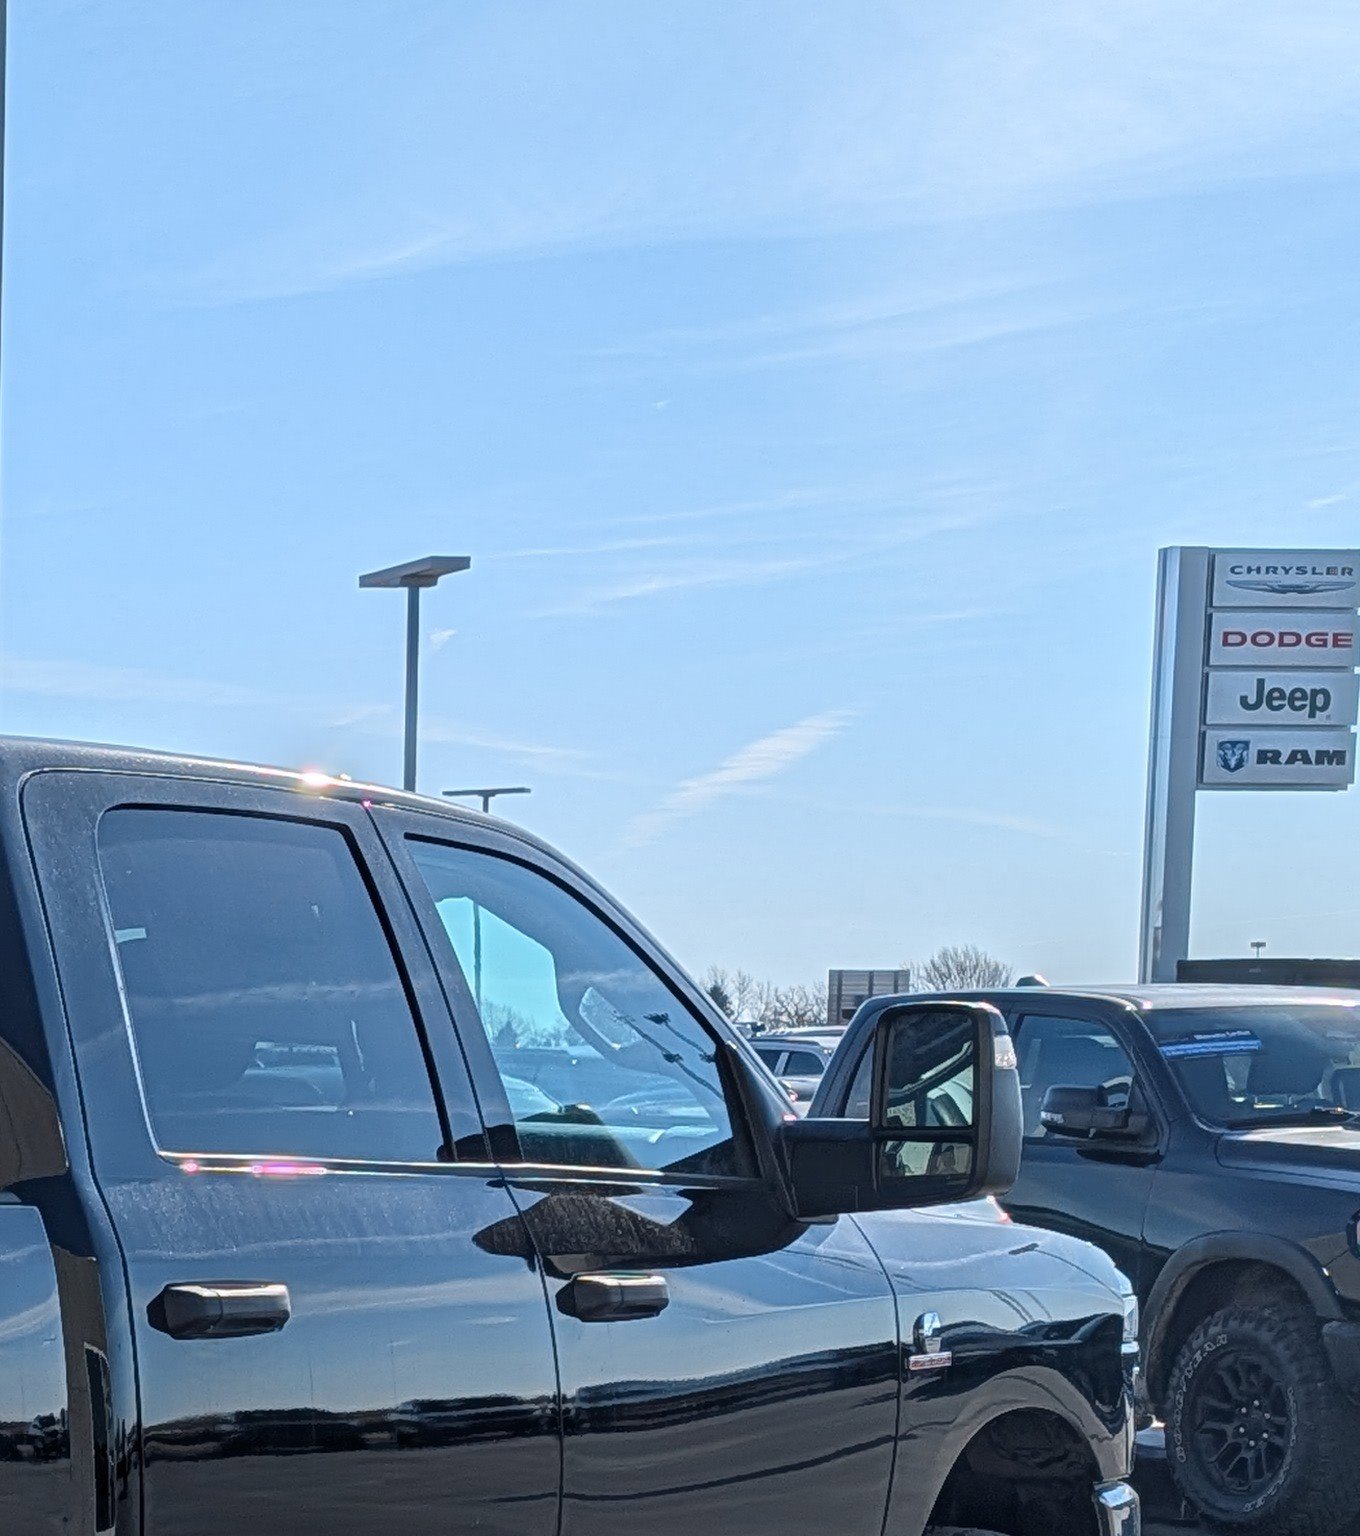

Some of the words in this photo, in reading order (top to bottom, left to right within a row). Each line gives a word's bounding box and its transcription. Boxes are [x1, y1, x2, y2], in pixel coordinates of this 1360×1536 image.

[1229, 565, 1355, 577] CHRYSLER
[1221, 630, 1354, 649] DODGE
[1239, 677, 1332, 719] Jeep
[1255, 748, 1347, 767] RAM
